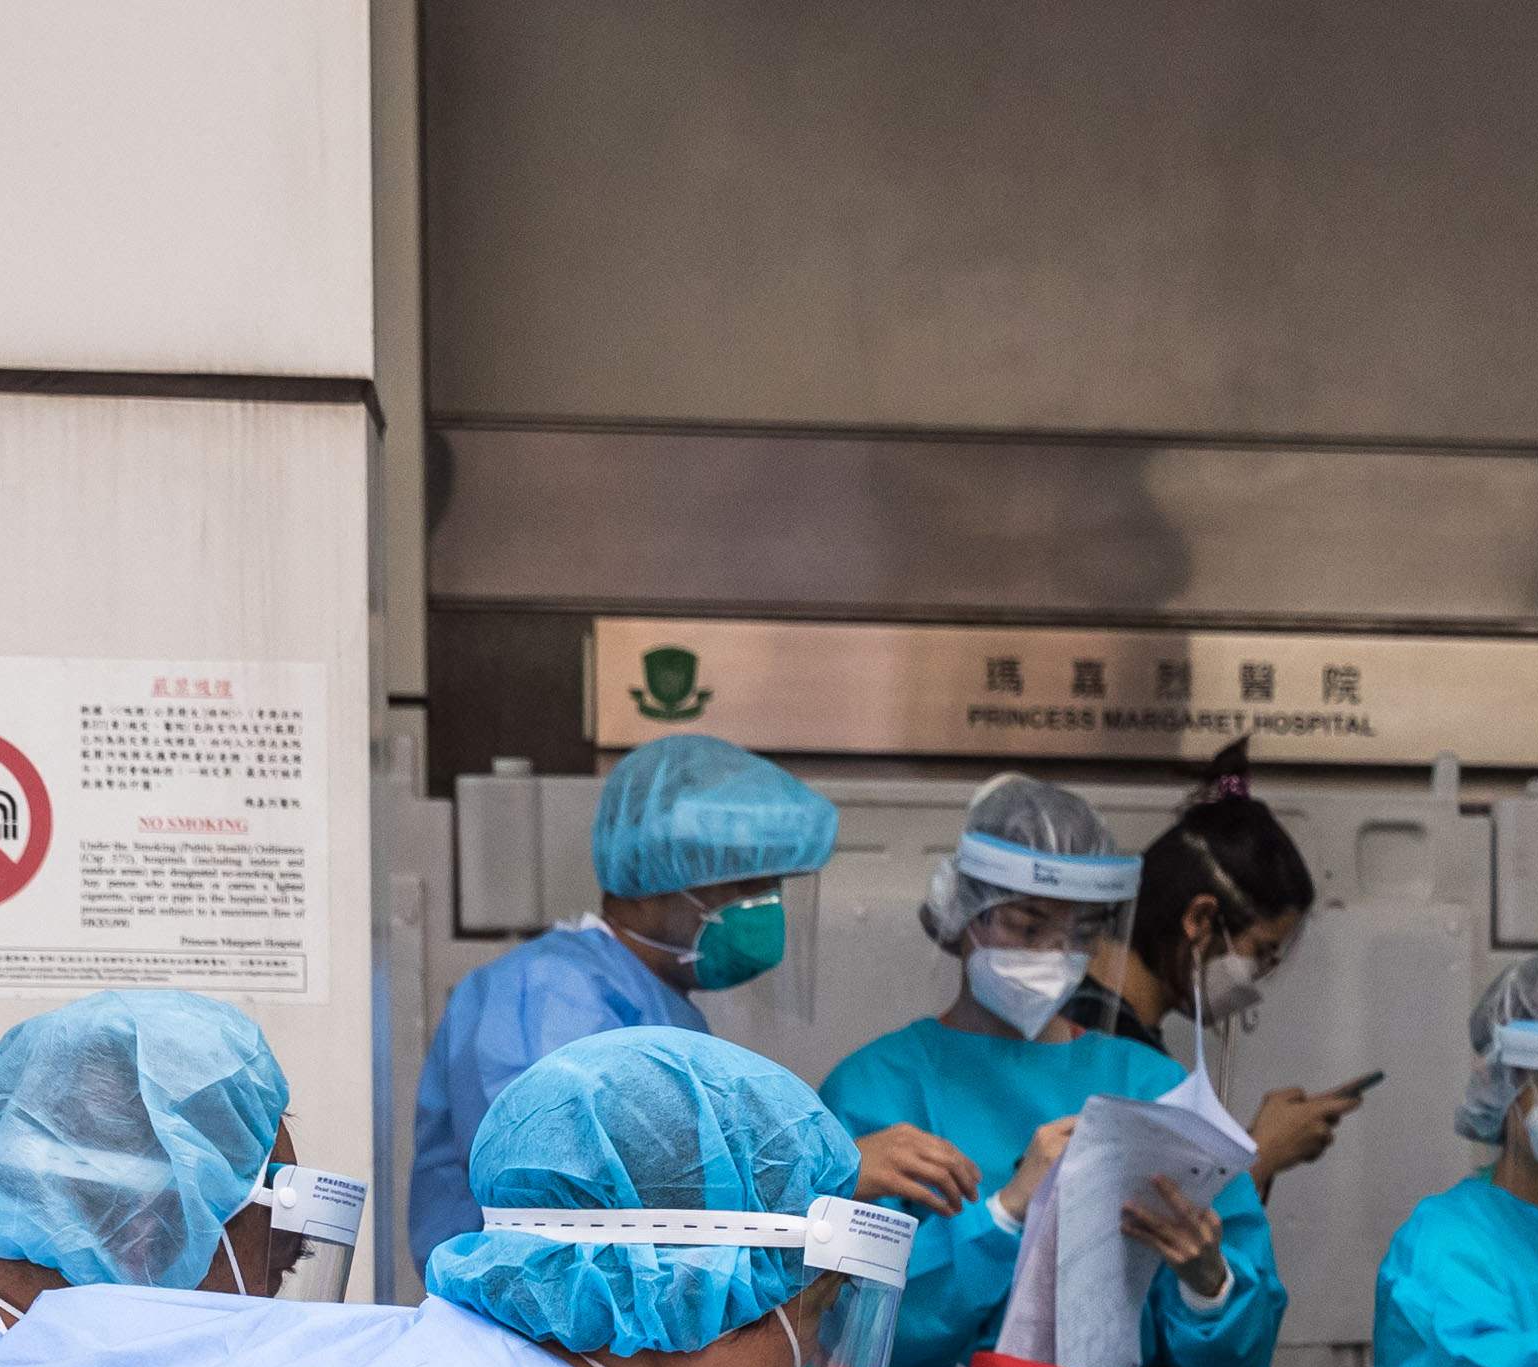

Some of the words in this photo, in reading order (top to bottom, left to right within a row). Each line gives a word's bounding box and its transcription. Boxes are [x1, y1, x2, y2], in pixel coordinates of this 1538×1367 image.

[986, 657, 1361, 704] 瑪嘉烈醫院
[968, 704, 1096, 731] PRINCESS
[1102, 708, 1247, 734] MARGARET
[1253, 713, 1374, 737] HOSPITAL
[140, 817, 163, 830] NO
[167, 818, 248, 832] SMOKING
